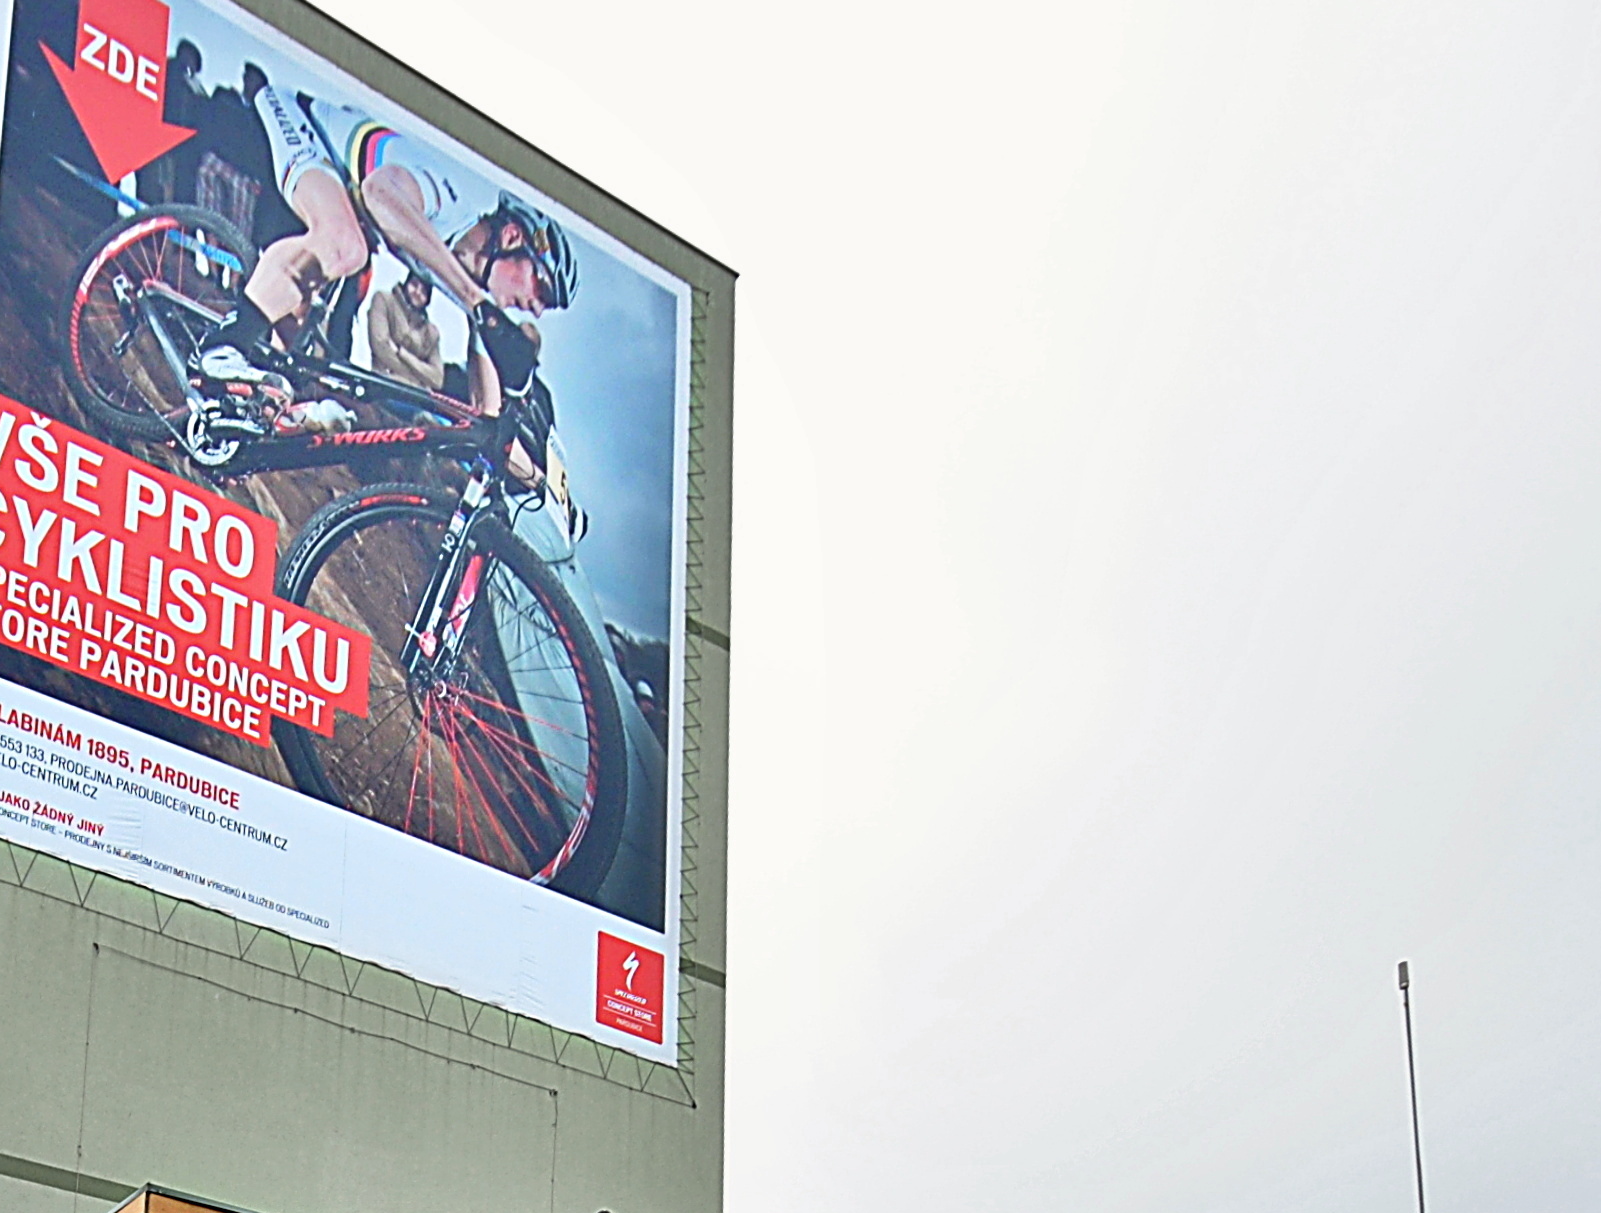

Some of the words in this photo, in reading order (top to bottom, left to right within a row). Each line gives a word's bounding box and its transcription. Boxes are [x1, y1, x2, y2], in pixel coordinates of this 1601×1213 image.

[80, 25, 160, 101] ZDE
[123, 469, 255, 578] PRO
[80, 640, 262, 739] PARDUBICE
[185, 645, 327, 727] CONCEPT
[0, 734, 23, 754] 553
[50, 752, 288, 851] PRODEJNA.PARDUBICE@VELO-CENTRUM.CZ
[32, 801, 74, 826] ŽÁDNÝ
[77, 819, 105, 837] JINÝ
[86, 738, 134, 773] 1895,
[140, 757, 241, 810] PARDUBICE
[30, 817, 57, 835] STORE
[64, 829, 105, 851] PRODEJNY
[153, 860, 206, 886] SORTIMENTEM
[286, 906, 330, 929] SPECIALIZED
